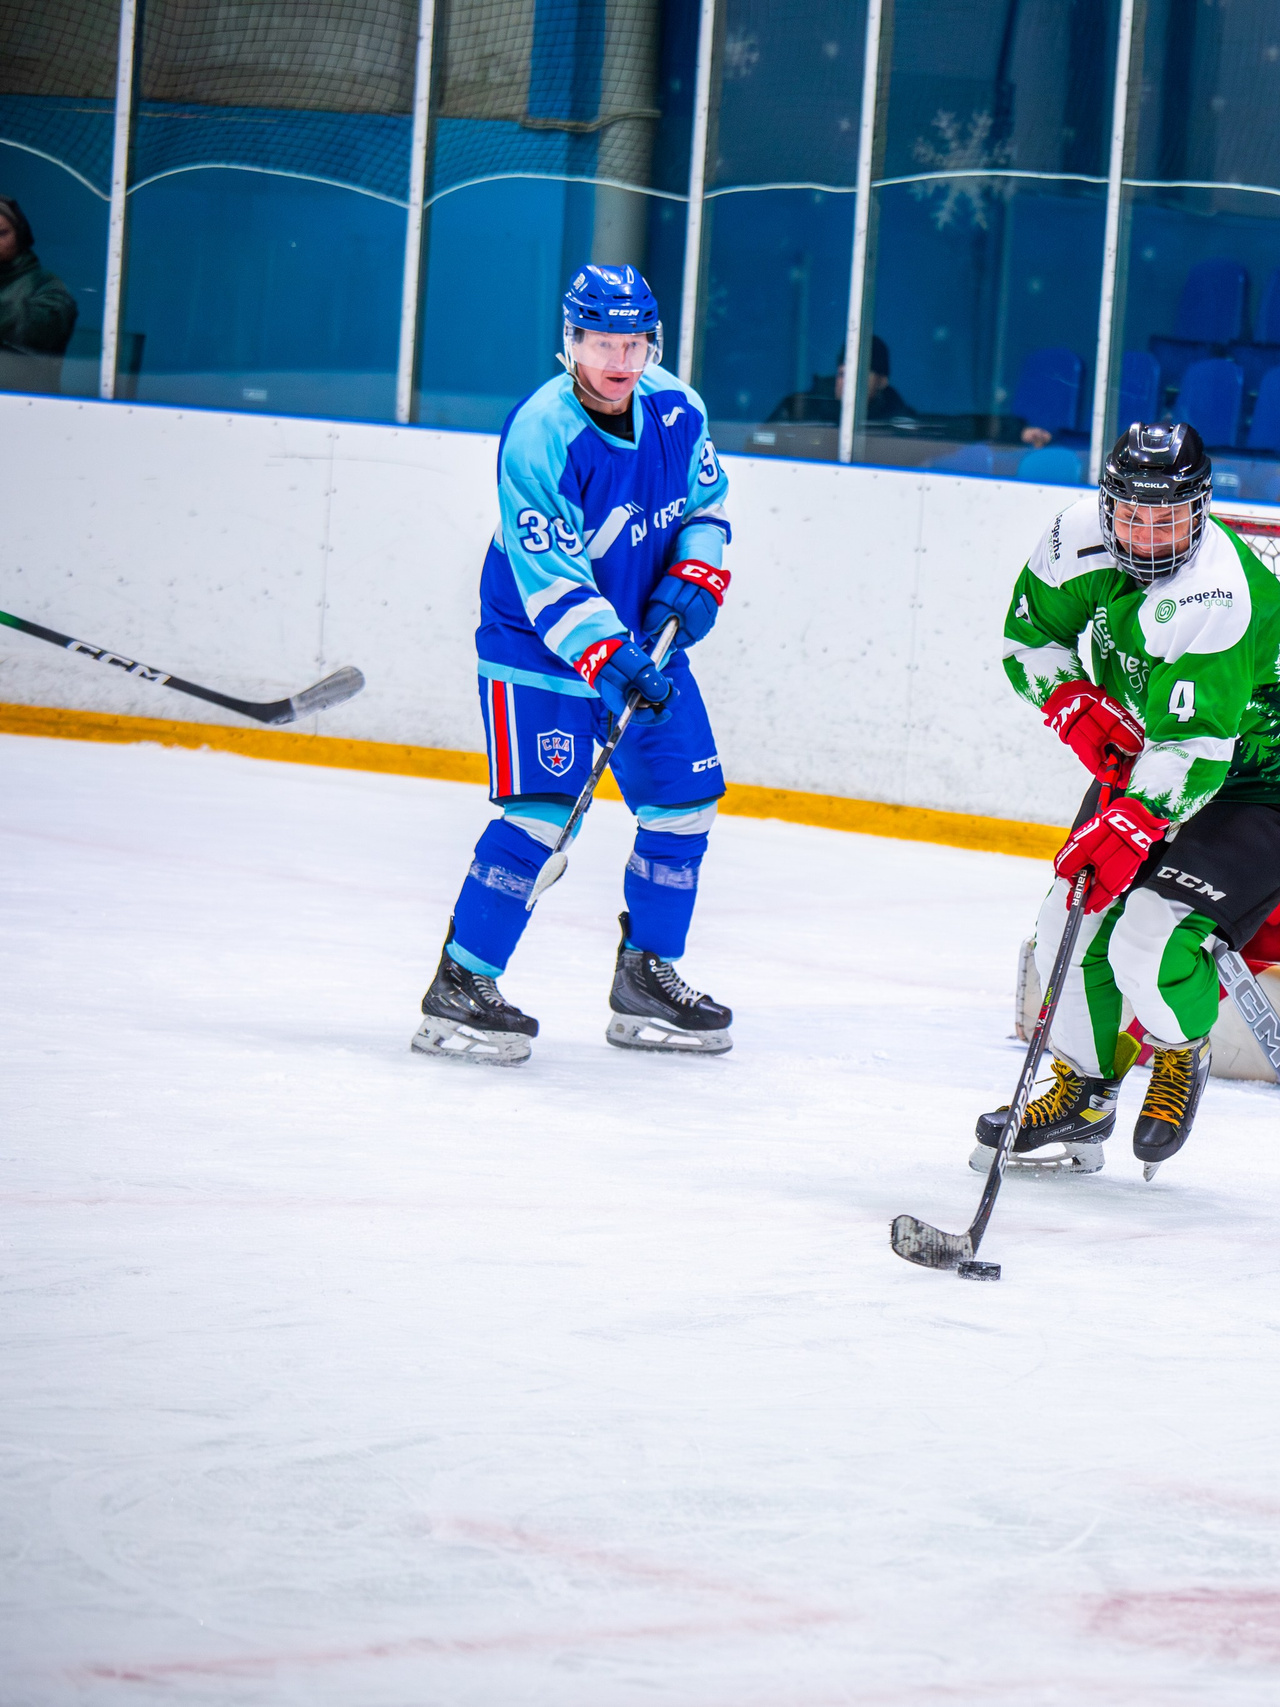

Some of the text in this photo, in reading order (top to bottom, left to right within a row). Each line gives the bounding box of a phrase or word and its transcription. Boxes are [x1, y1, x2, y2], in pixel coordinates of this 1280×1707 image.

[608, 308, 640, 317] CCM
[698, 438, 724, 486] 3
[1132, 481, 1170, 490] TACKLA
[517, 508, 585, 558] 39
[681, 564, 729, 600] CC
[1179, 588, 1233, 606] segezha
[1204, 598, 1233, 609] group
[67, 640, 171, 685] CCM
[580, 644, 607, 683] CM
[1051, 697, 1080, 733] CM
[1168, 680, 1196, 723] 4
[542, 737, 570, 752] СКА
[1108, 813, 1153, 851] CC
[1157, 866, 1227, 902] CCM
